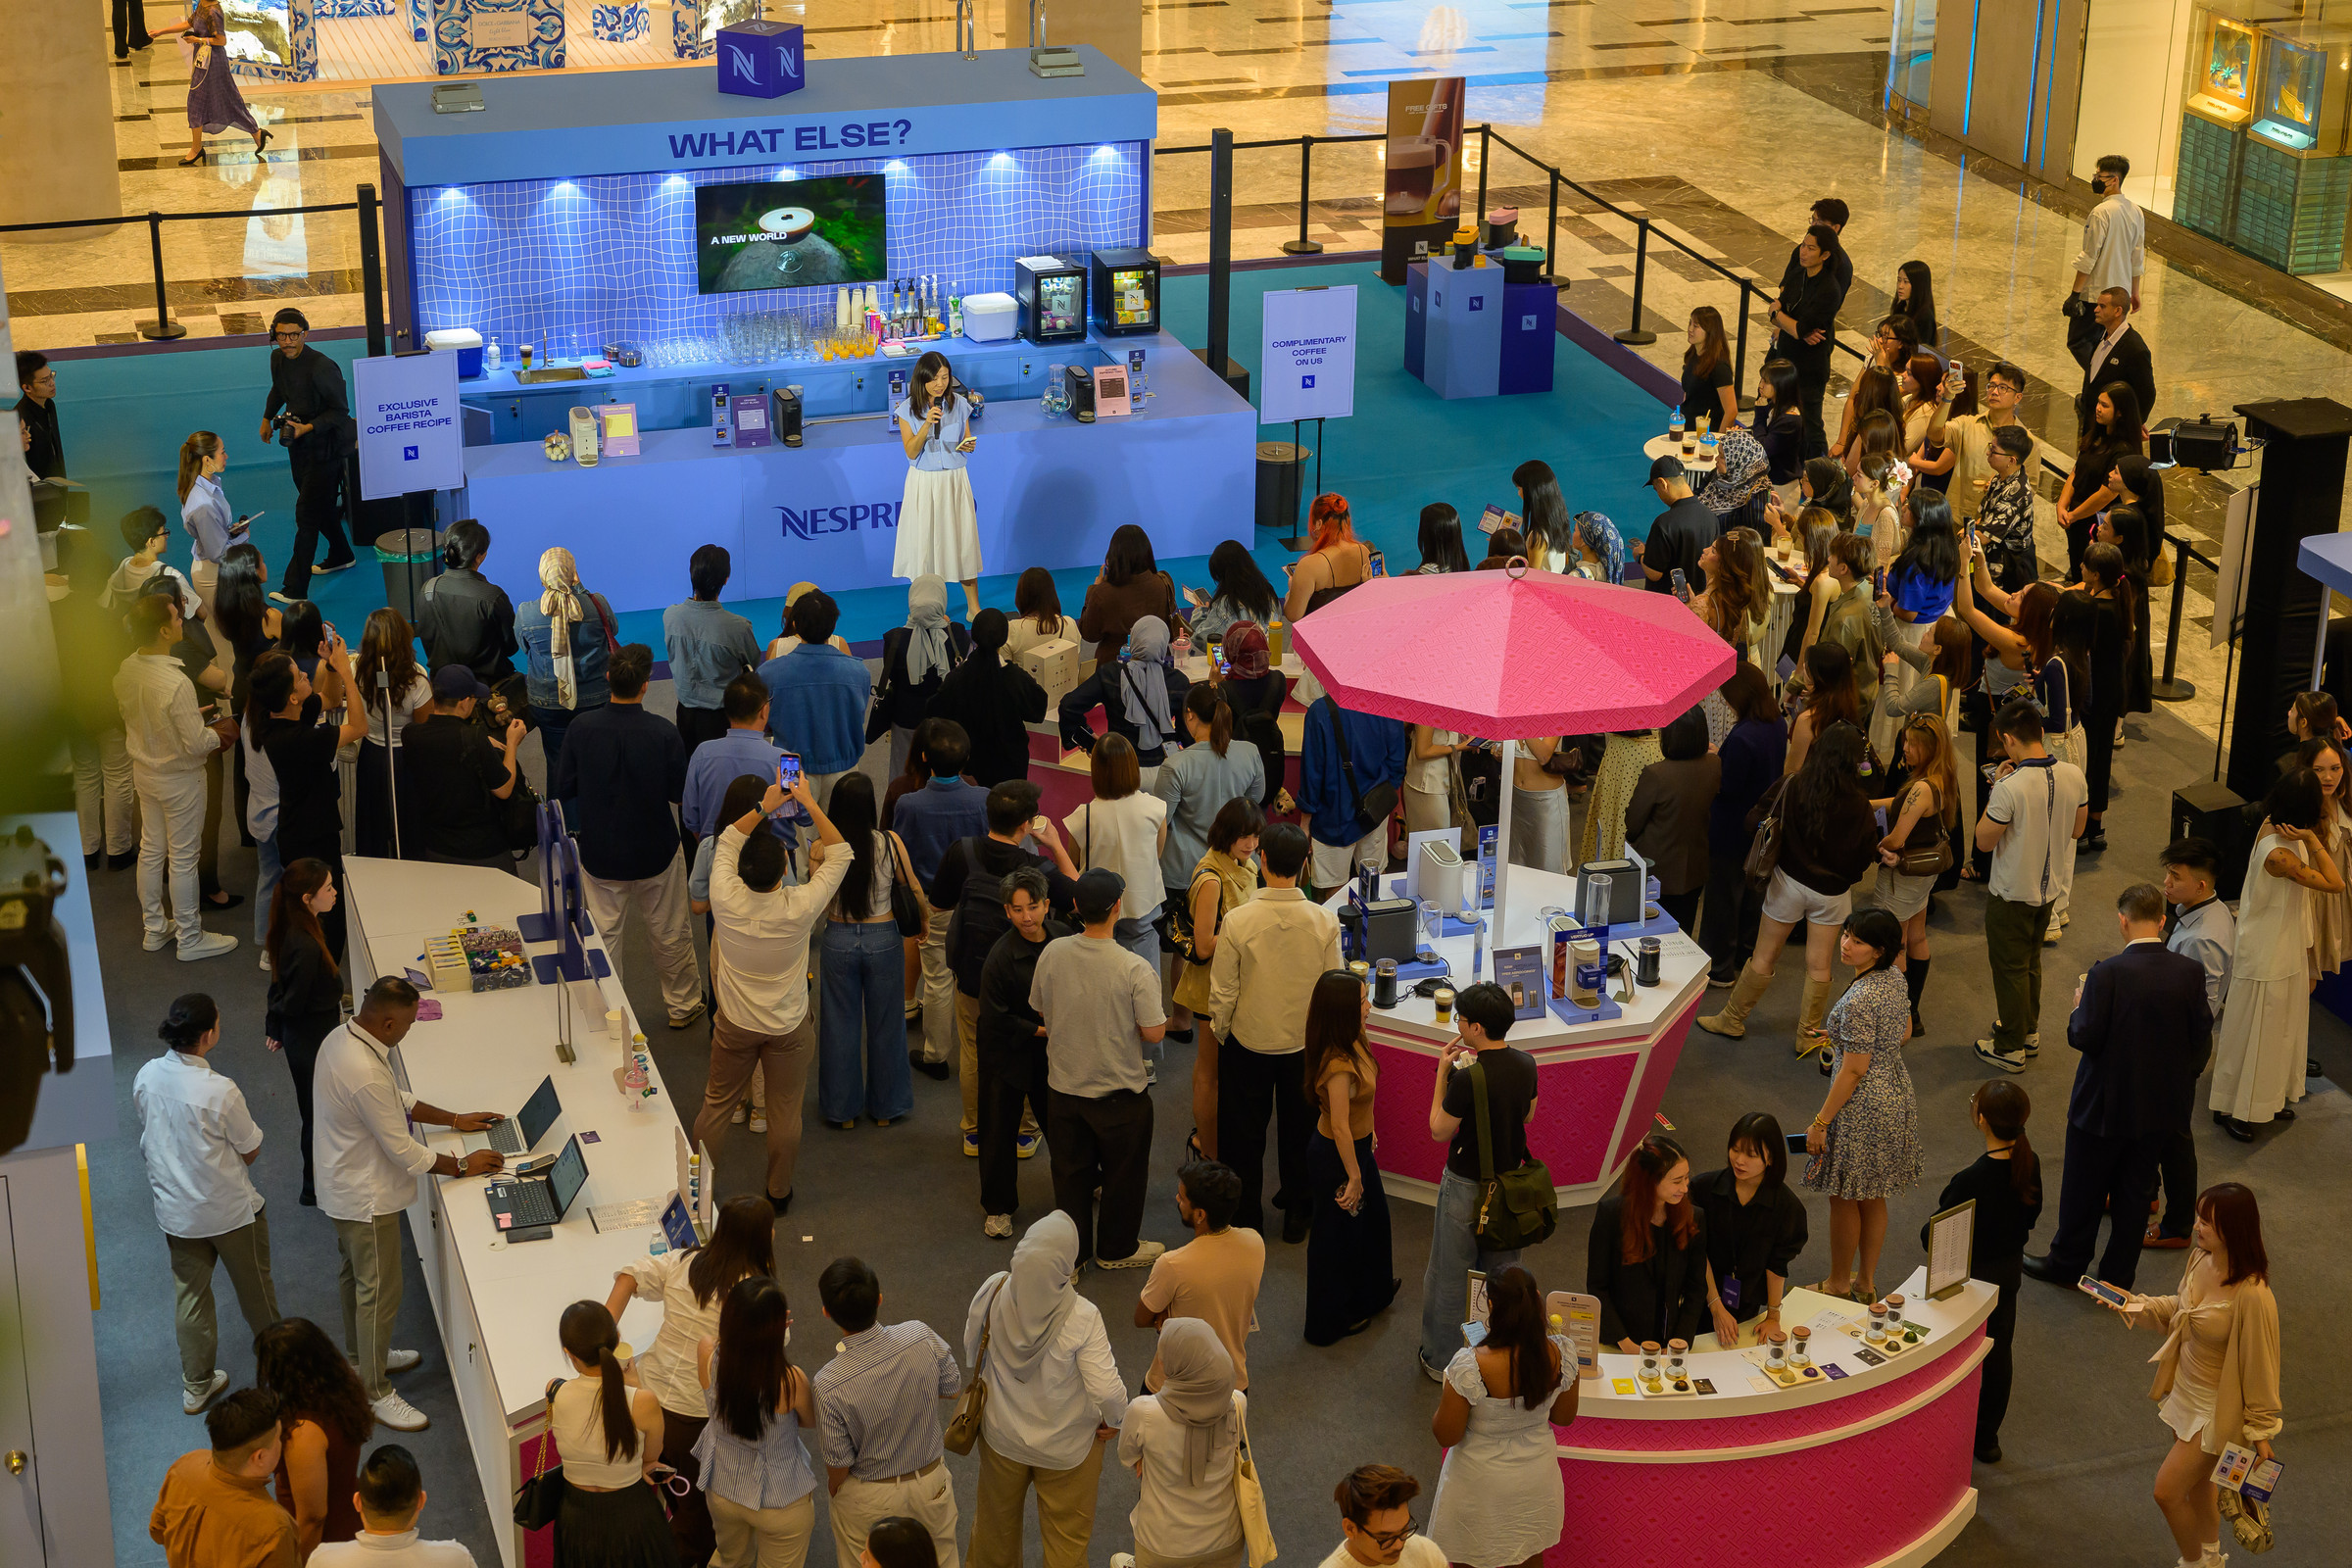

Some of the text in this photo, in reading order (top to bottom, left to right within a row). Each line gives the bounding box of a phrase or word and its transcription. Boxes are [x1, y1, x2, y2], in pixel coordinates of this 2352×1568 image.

[667, 119, 912, 159] WHAT ELSE?
[710, 231, 788, 245] A NEW WORLD
[1272, 336, 1347, 348] COMPLIMENTARY
[1292, 348, 1327, 357] COFFEE
[378, 398, 438, 413] EXCLUSIVE
[385, 410, 432, 421] BARISTA
[367, 417, 452, 434] COFFEE RECIPE
[771, 501, 903, 540] NESPR
